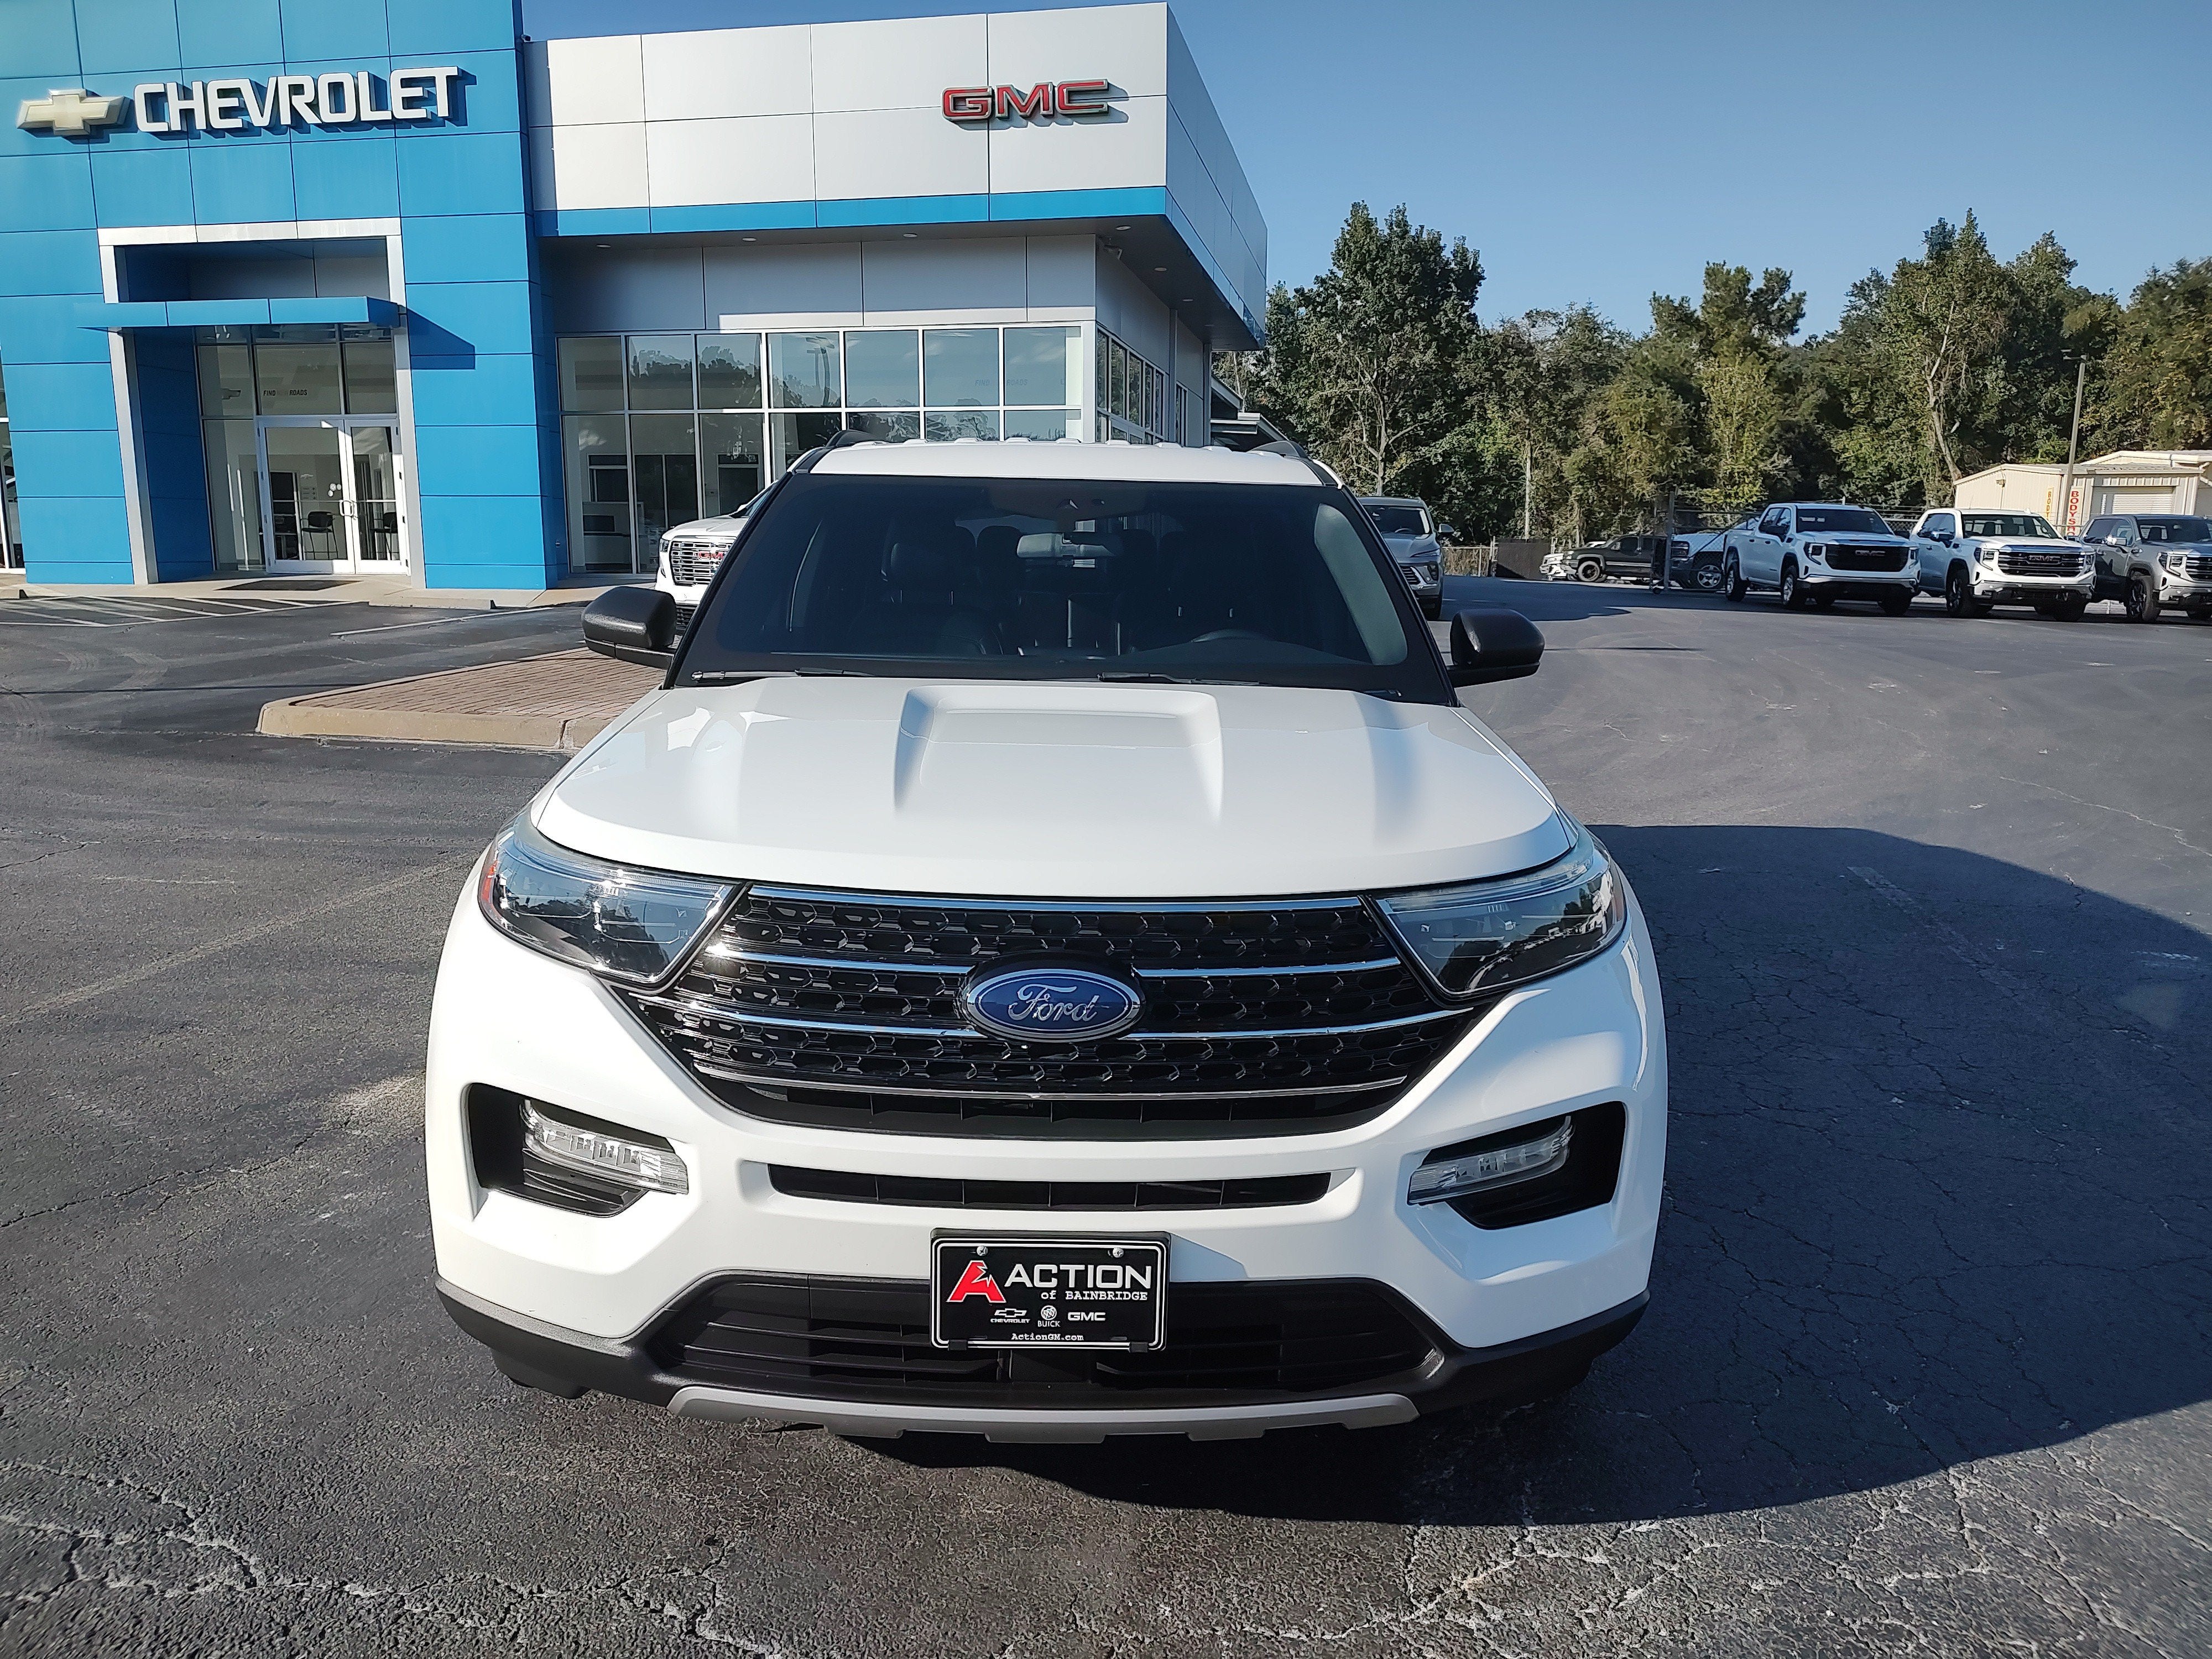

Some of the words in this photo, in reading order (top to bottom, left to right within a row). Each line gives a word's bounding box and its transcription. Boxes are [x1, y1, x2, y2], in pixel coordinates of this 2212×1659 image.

[134, 66, 458, 132] CHEVROLET
[942, 79, 1108, 121] GMC
[698, 551, 725, 560] GM
[1008, 984, 1098, 1022] Ford
[1004, 1264, 1152, 1289] ACTION
[1041, 1291, 1056, 1300] of
[1065, 1291, 1148, 1301] BAINBRIDGE
[1068, 1312, 1106, 1321] GMC
